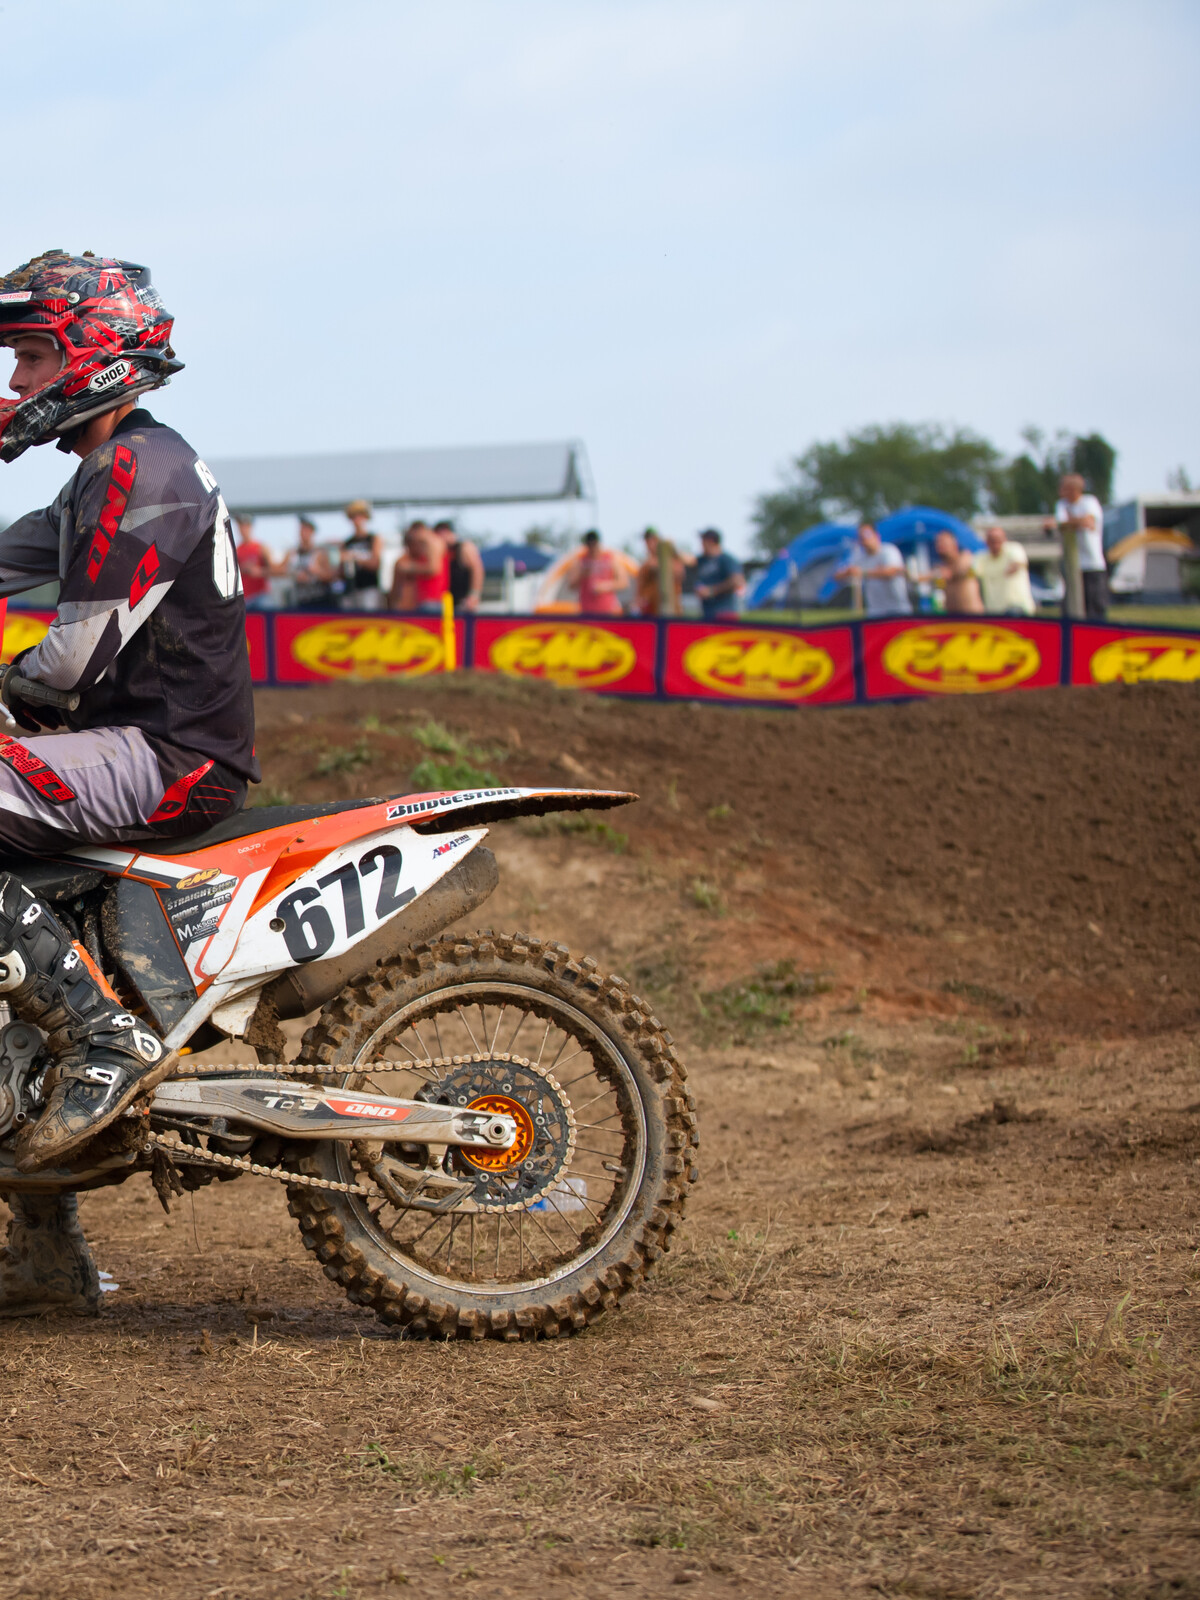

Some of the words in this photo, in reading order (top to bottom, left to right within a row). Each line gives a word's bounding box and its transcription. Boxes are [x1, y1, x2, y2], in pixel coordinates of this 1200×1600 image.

[94, 363, 126, 388] SHOEI
[388, 788, 520, 819] BRIDGESTONE
[432, 840, 457, 860] AMA
[176, 868, 221, 890] FMF
[171, 905, 199, 922] CHOICE
[201, 893, 232, 911] HOTELS
[277, 845, 416, 963] 672
